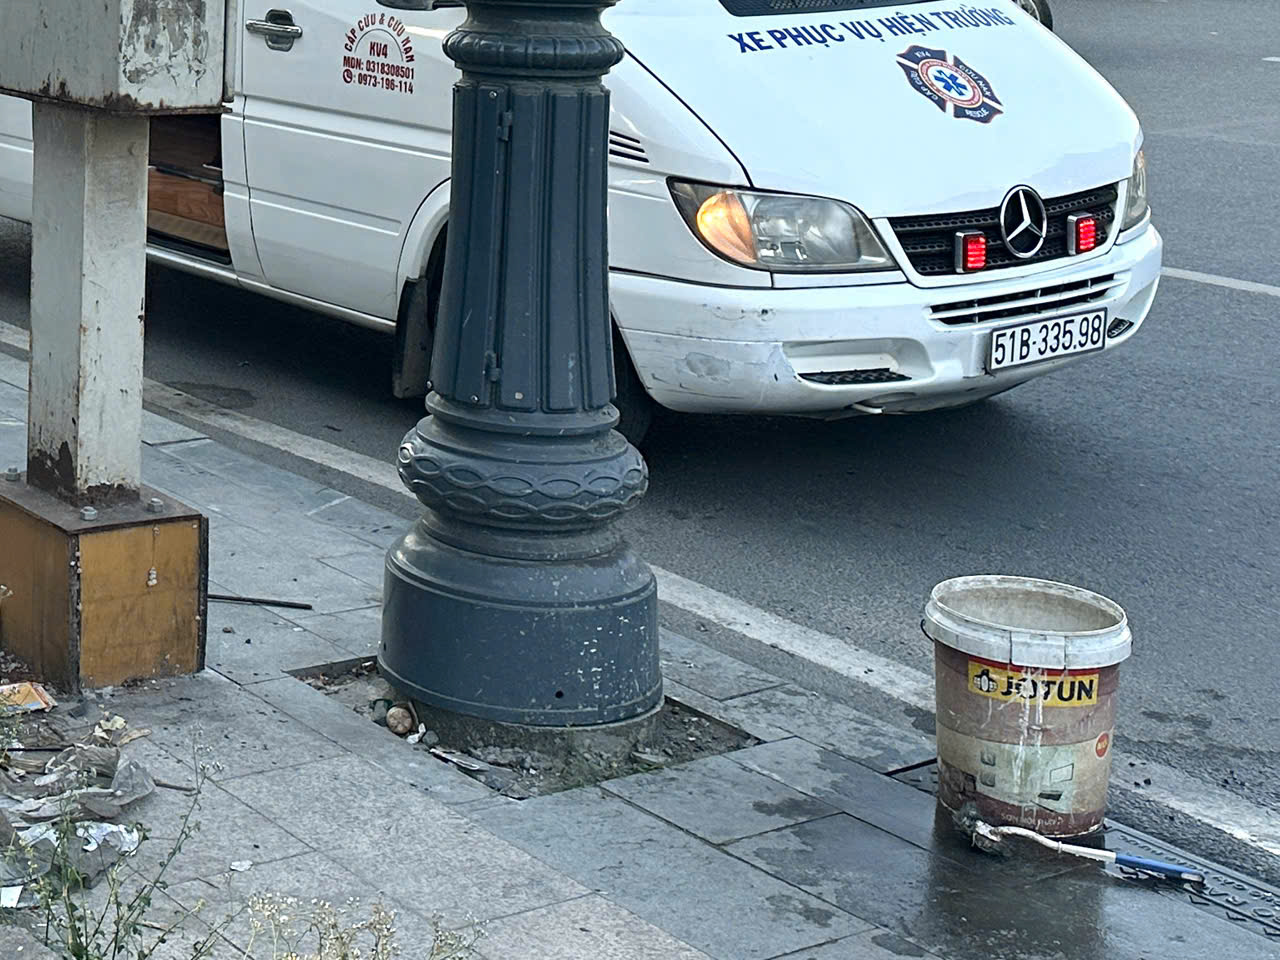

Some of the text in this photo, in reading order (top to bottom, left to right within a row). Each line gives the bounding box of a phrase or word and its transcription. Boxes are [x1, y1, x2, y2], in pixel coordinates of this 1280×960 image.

[344, 27, 358, 53] CẤP
[378, 12, 386, 26] &
[728, 2, 1016, 54] XE PHỤC VỤ HIỆN TRƯỜNG
[365, 59, 415, 80] 0318308501
[369, 41, 389, 59] KV4
[994, 313, 1103, 366] 51B-335.98
